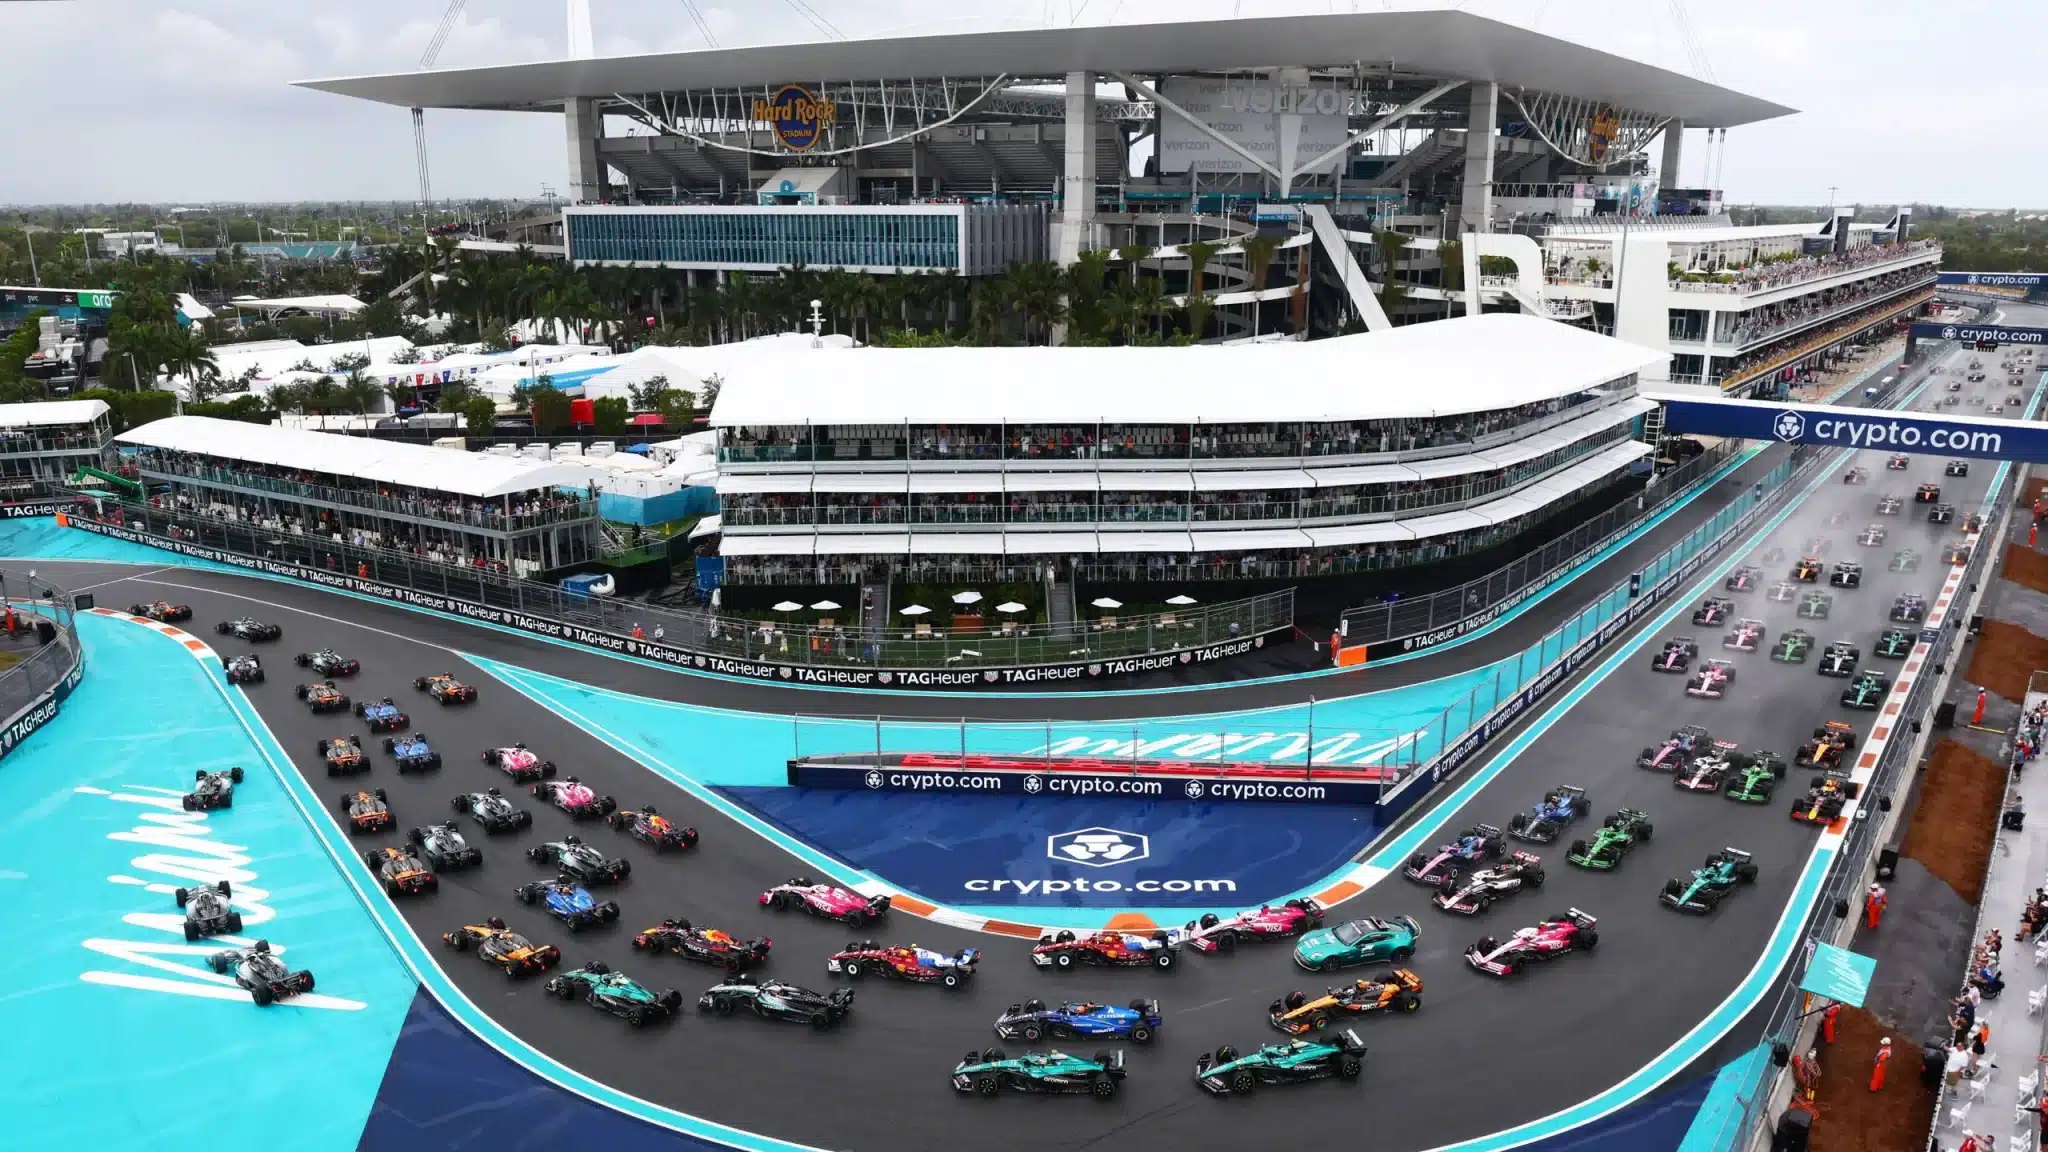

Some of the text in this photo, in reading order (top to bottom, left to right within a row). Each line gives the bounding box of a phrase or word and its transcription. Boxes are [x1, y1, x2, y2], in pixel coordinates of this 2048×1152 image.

[754, 97, 835, 124] Hard Rock
[782, 130, 812, 138] STADIUM
[1981, 275, 2040, 286] crypto.com
[1960, 328, 2042, 342] crypto.com
[1815, 418, 2001, 453] crypto.com
[1534, 666, 1563, 696] crypto.com
[1491, 698, 1523, 731] crypto.com
[1441, 734, 1479, 772] crypto.com
[890, 772, 1001, 792] crypto.com
[1049, 777, 1161, 797] crypto.com
[1211, 782, 1325, 803] crypto.com
[964, 877, 1237, 895] crypto.com
[814, 900, 832, 913] VISA
[1265, 922, 1283, 933] VISA
